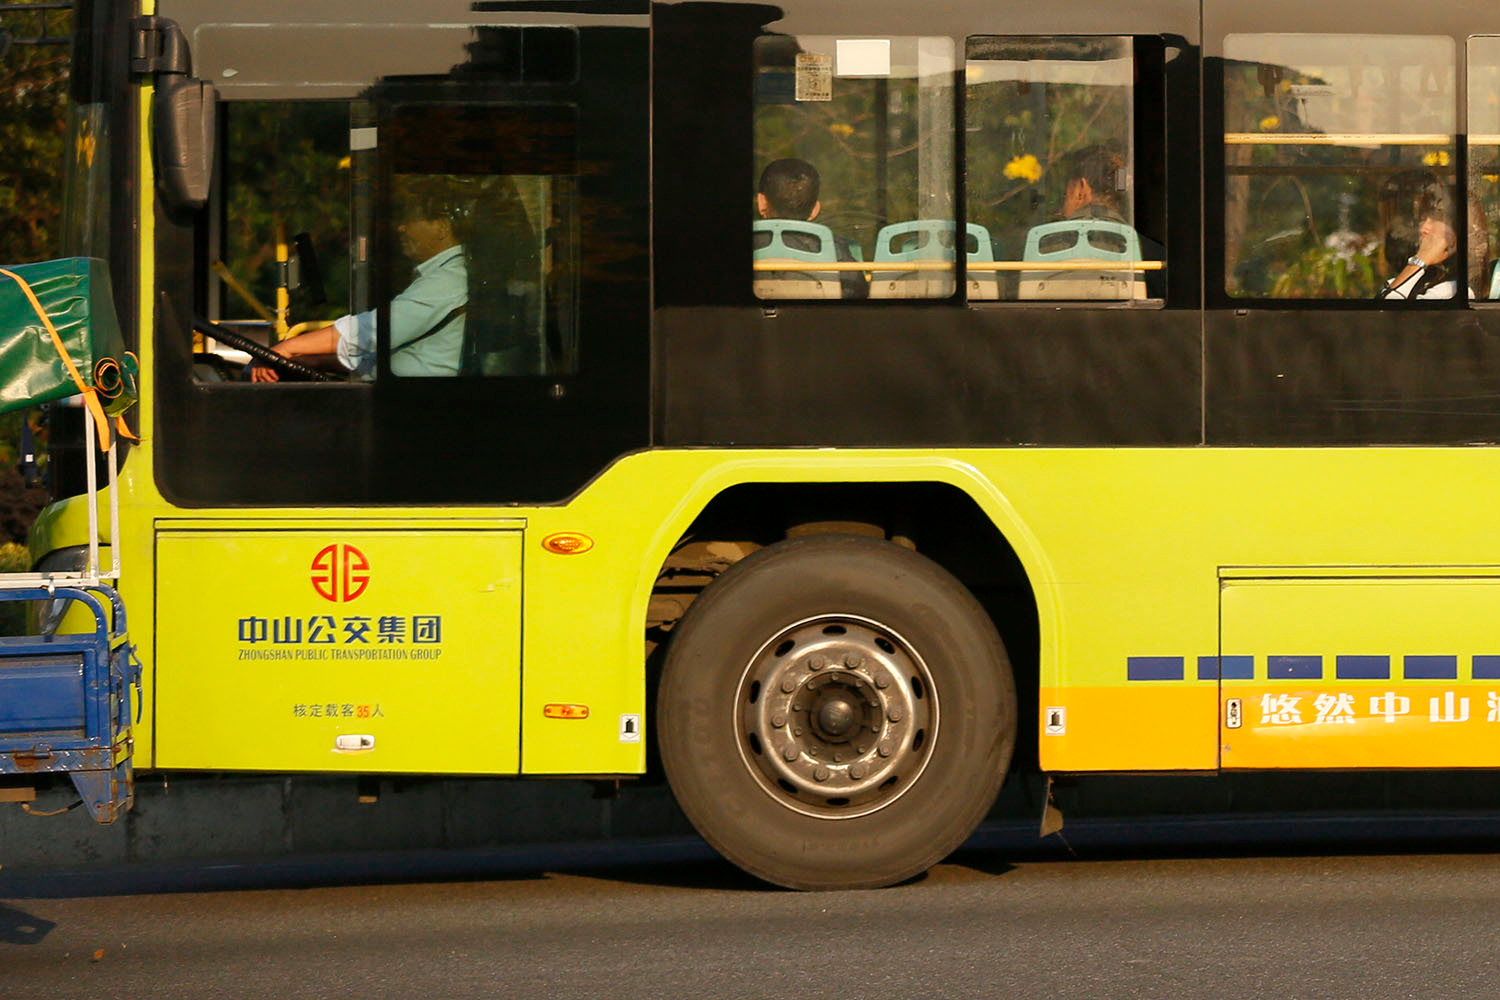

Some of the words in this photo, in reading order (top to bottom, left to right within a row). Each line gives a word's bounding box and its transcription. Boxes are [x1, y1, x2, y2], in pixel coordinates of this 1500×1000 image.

[238, 616, 441, 644] 中山公交集团
[238, 649, 293, 661] ZHONGSHAN
[295, 649, 328, 661] PUBLIC
[331, 649, 408, 661] TRANSPORTATION
[410, 649, 442, 661] GROUP
[293, 704, 384, 718] 核定载客35人
